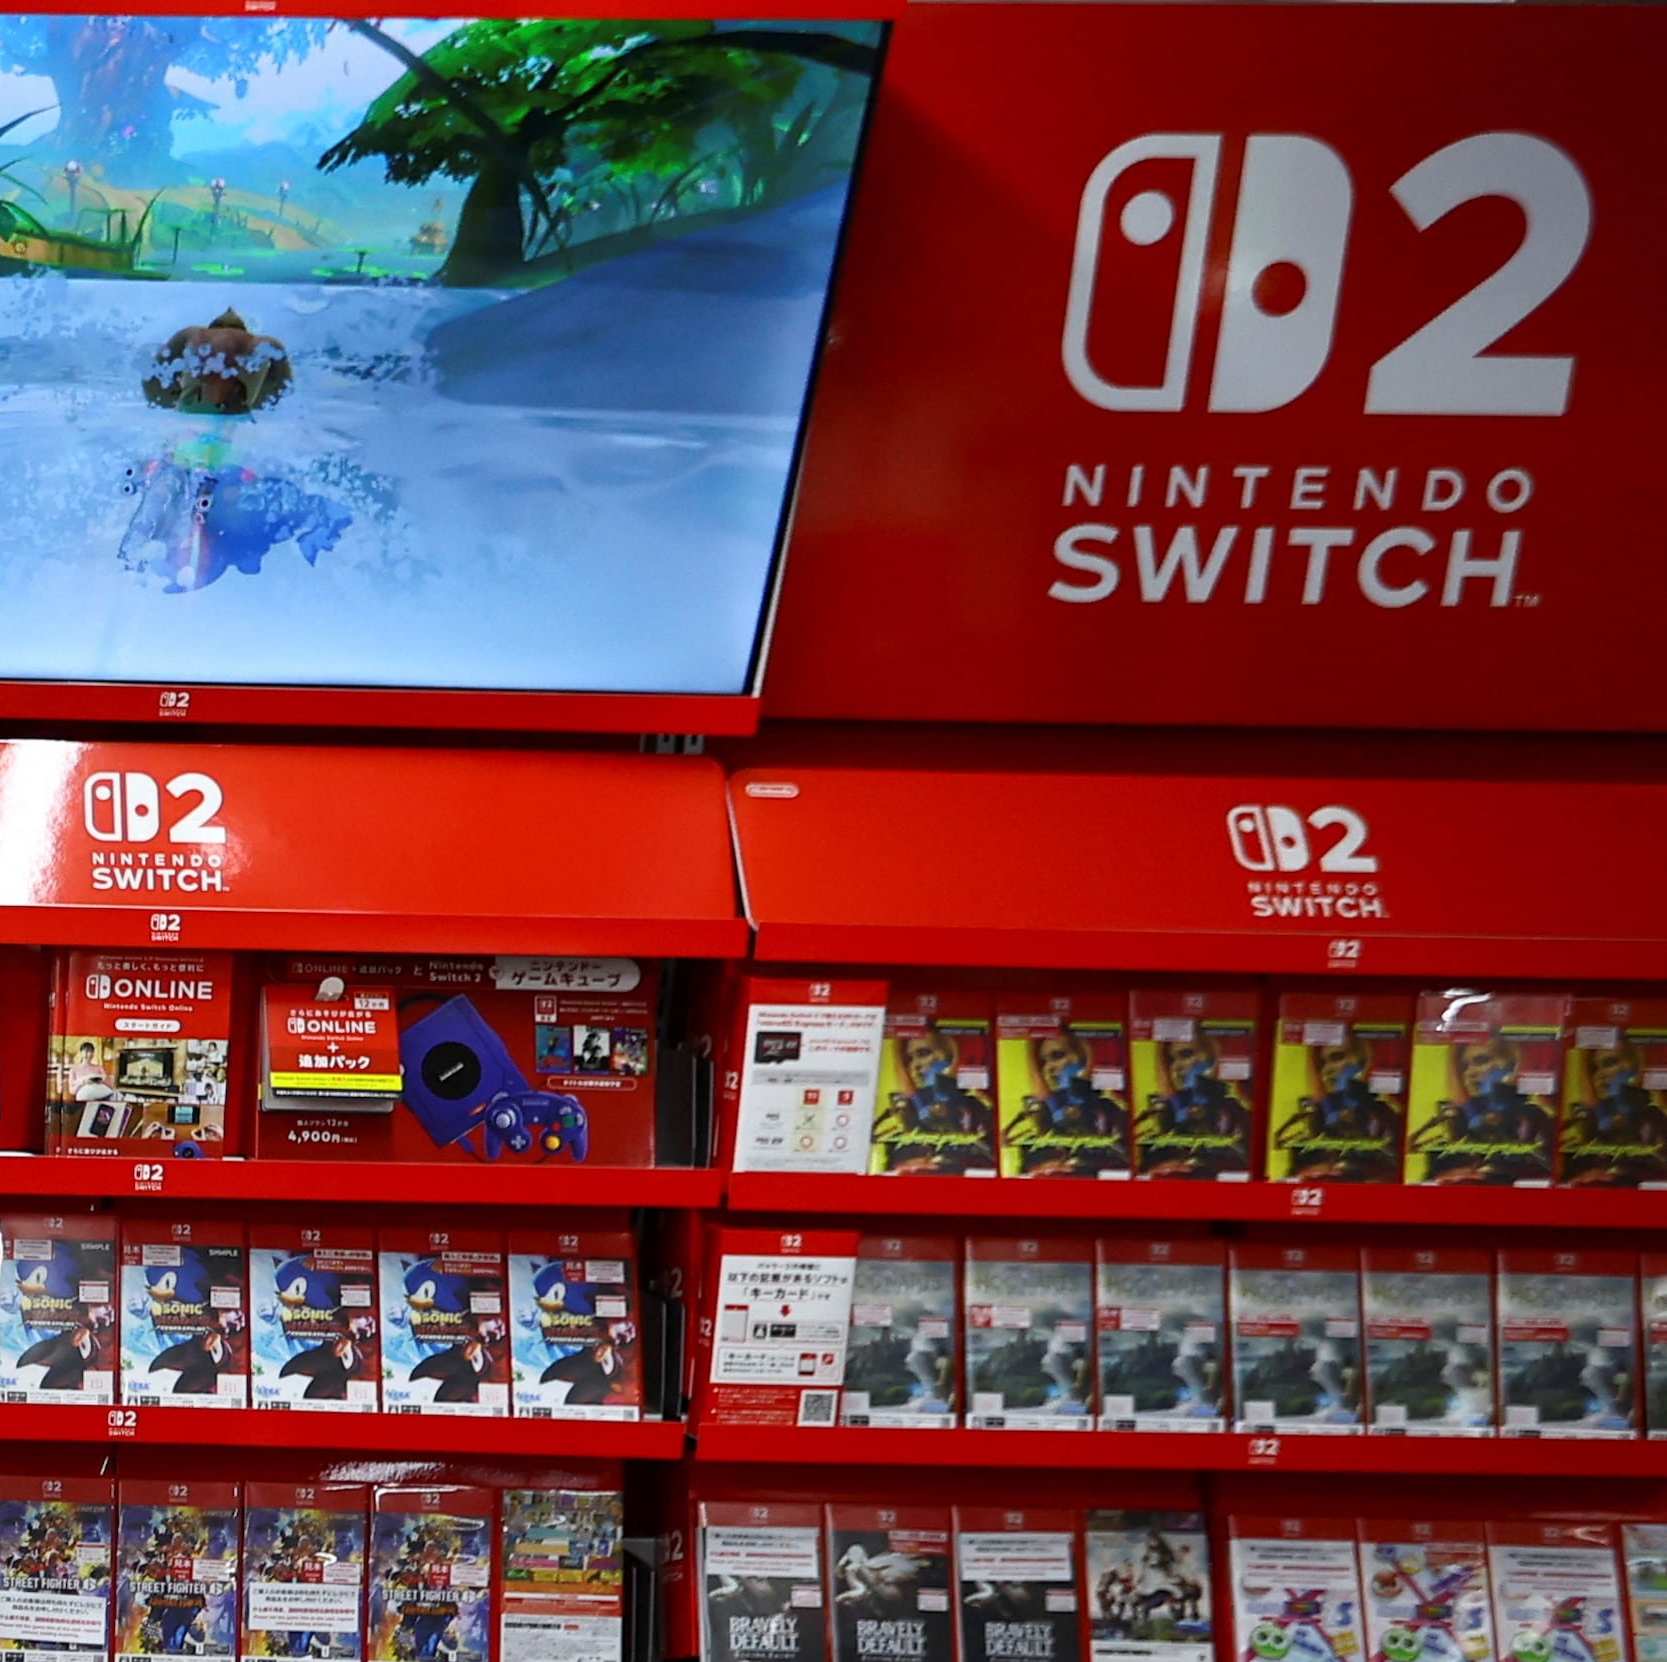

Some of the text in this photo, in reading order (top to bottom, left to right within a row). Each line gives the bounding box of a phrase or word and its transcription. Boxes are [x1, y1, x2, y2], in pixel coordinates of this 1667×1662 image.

[1364, 132, 1591, 416] 2
[1063, 464, 1531, 512] NINTENDO
[1049, 524, 1522, 607] SWITCH
[177, 692, 189, 707] 2
[166, 773, 226, 843] 2
[1305, 806, 1377, 872] 2
[92, 852, 223, 867] NINTENDO
[92, 867, 222, 892] SWITCH
[1251, 895, 1382, 917] SWITCH
[115, 979, 213, 999] ONLINE
[308, 1018, 376, 1033] ONLINE
[298, 1054, 371, 1070] 追加パック
